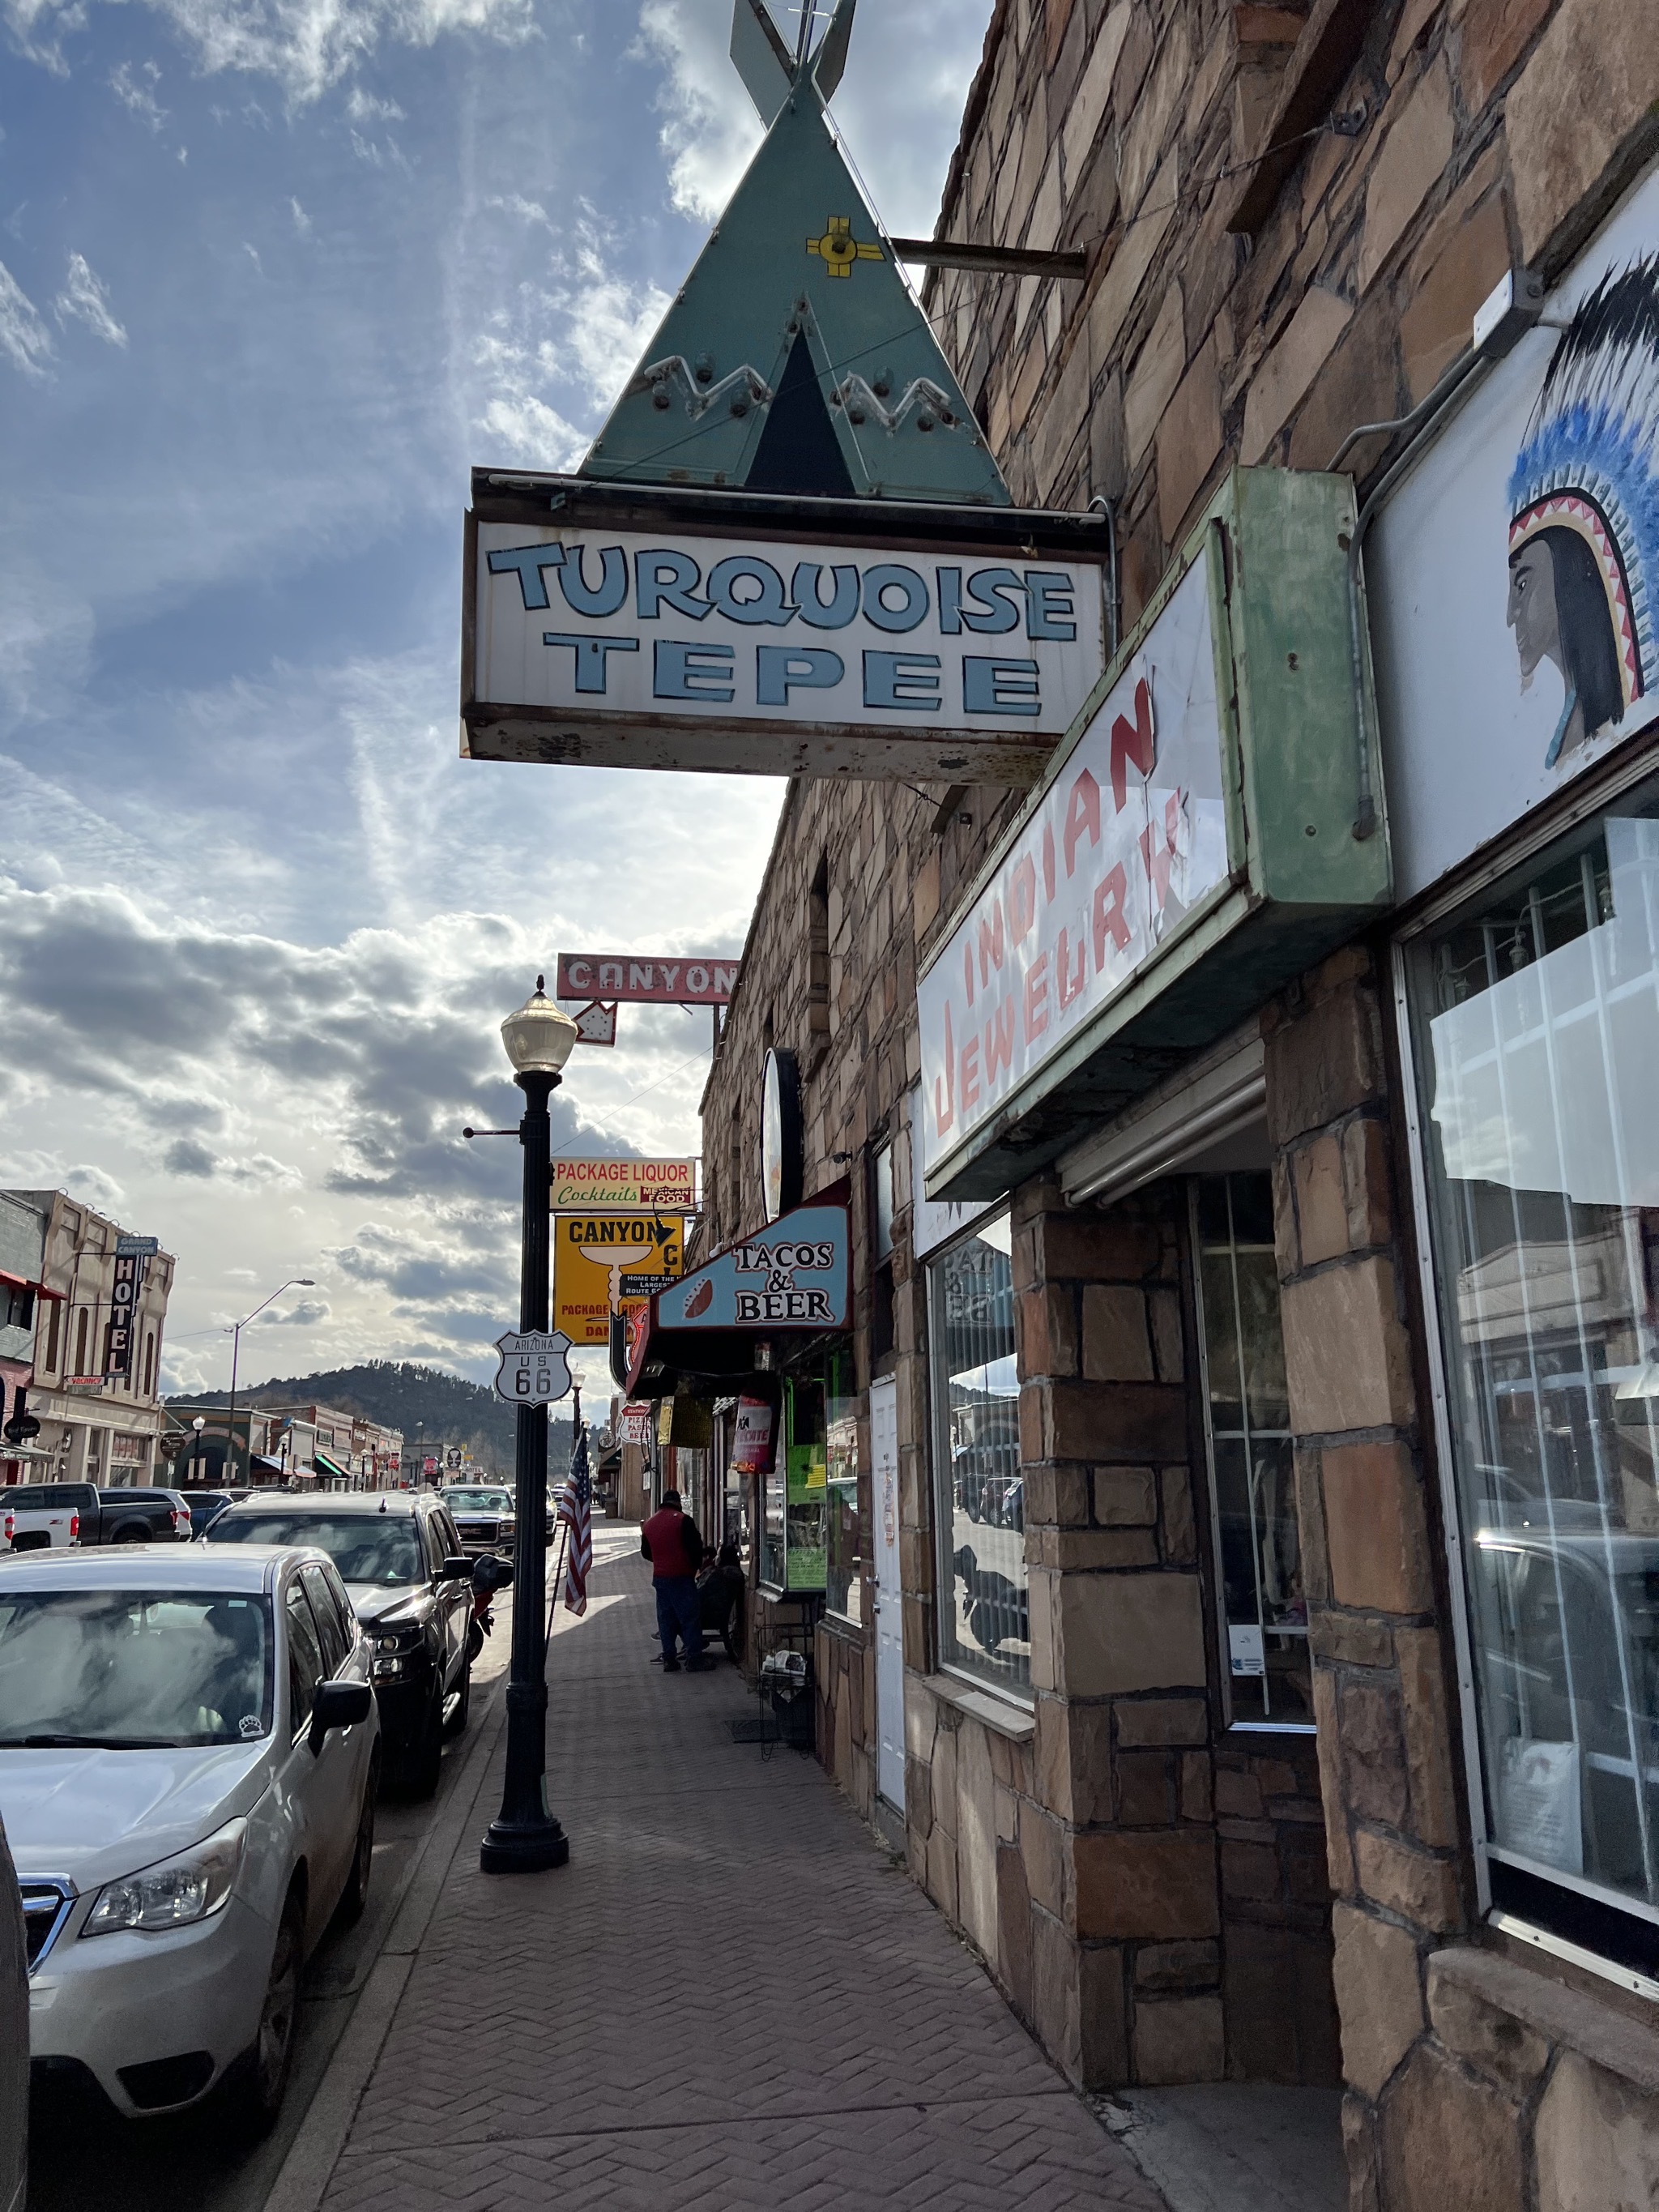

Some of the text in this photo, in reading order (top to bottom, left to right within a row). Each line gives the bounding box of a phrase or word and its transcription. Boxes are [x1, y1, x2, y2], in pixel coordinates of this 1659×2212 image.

[486, 540, 1077, 643] TURQUOISE
[542, 632, 1042, 717] TEPEE
[964, 676, 1155, 1008] INDIAN
[569, 961, 737, 994] CANYON
[557, 1163, 689, 1182] PACKAGE LIQUOR
[557, 1185, 638, 1205] Cocktails
[642, 1188, 689, 1196] MEXICAN
[121, 1237, 152, 1245] GRAND
[569, 1221, 657, 1243] CANYON
[735, 1245, 831, 1269] TACOS
[769, 1269, 792, 1293] &
[109, 1259, 134, 1373] HOTEL
[561, 1305, 608, 1315] PACKAGE
[738, 1292, 831, 1321] BEER
[514, 1339, 554, 1351] ARIZONA
[515, 1368, 551, 1395] 66
